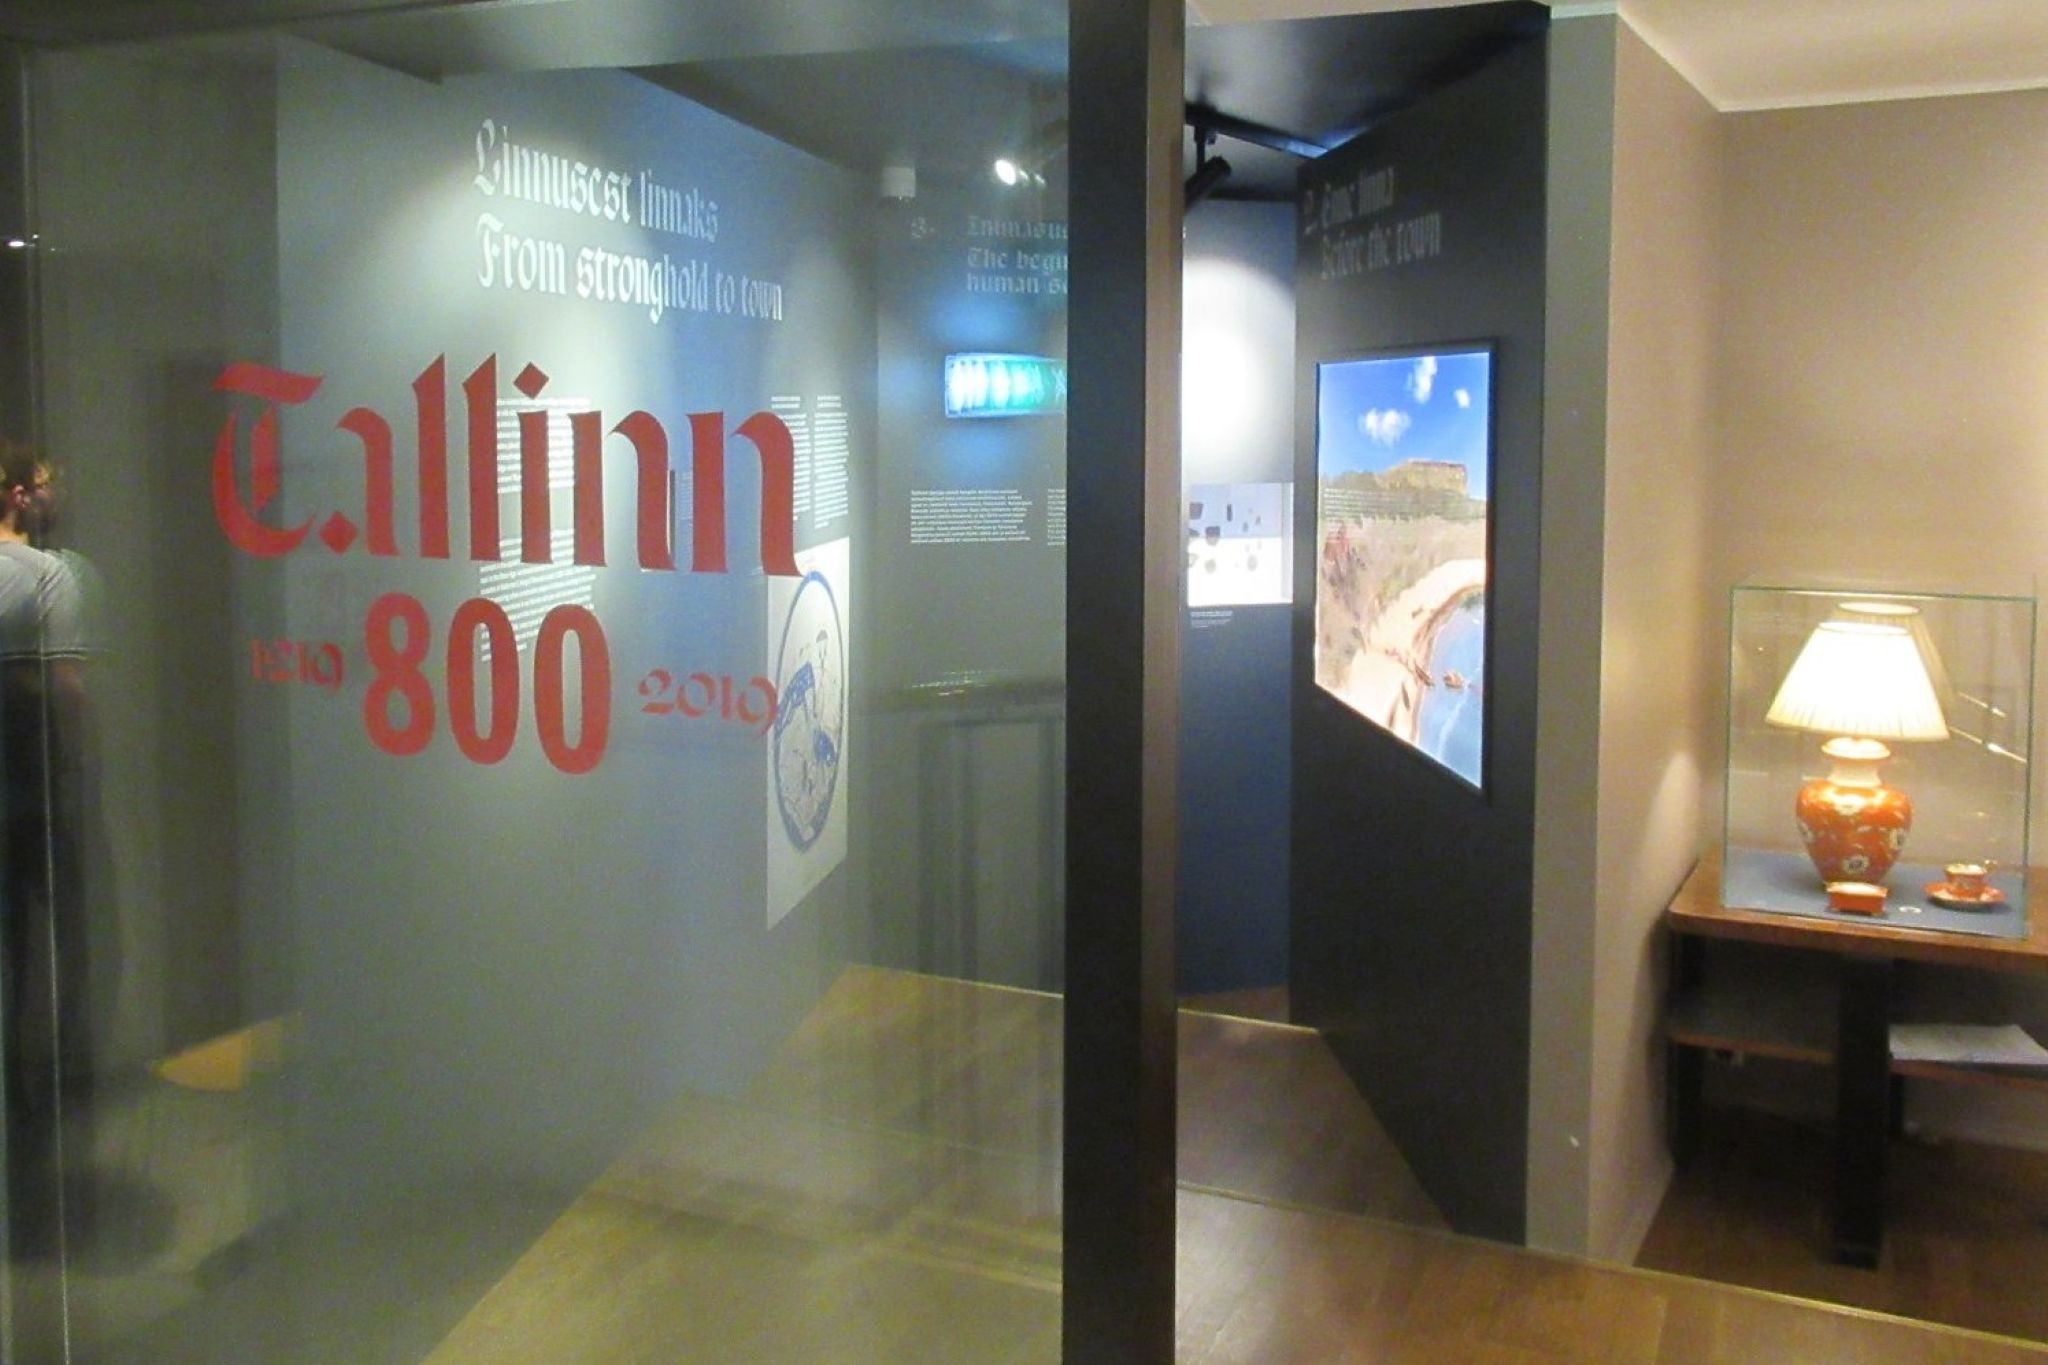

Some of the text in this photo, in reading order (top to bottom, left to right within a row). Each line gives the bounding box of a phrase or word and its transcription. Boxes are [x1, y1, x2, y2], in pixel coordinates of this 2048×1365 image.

[474, 119, 718, 243] Linnusest linnaks
[477, 213, 783, 324] From stronghold to town
[967, 248, 1008, 269] The
[967, 272, 1039, 293] human
[211, 353, 804, 577] Tallinn
[362, 592, 611, 774] 800
[638, 668, 778, 738] 2019
